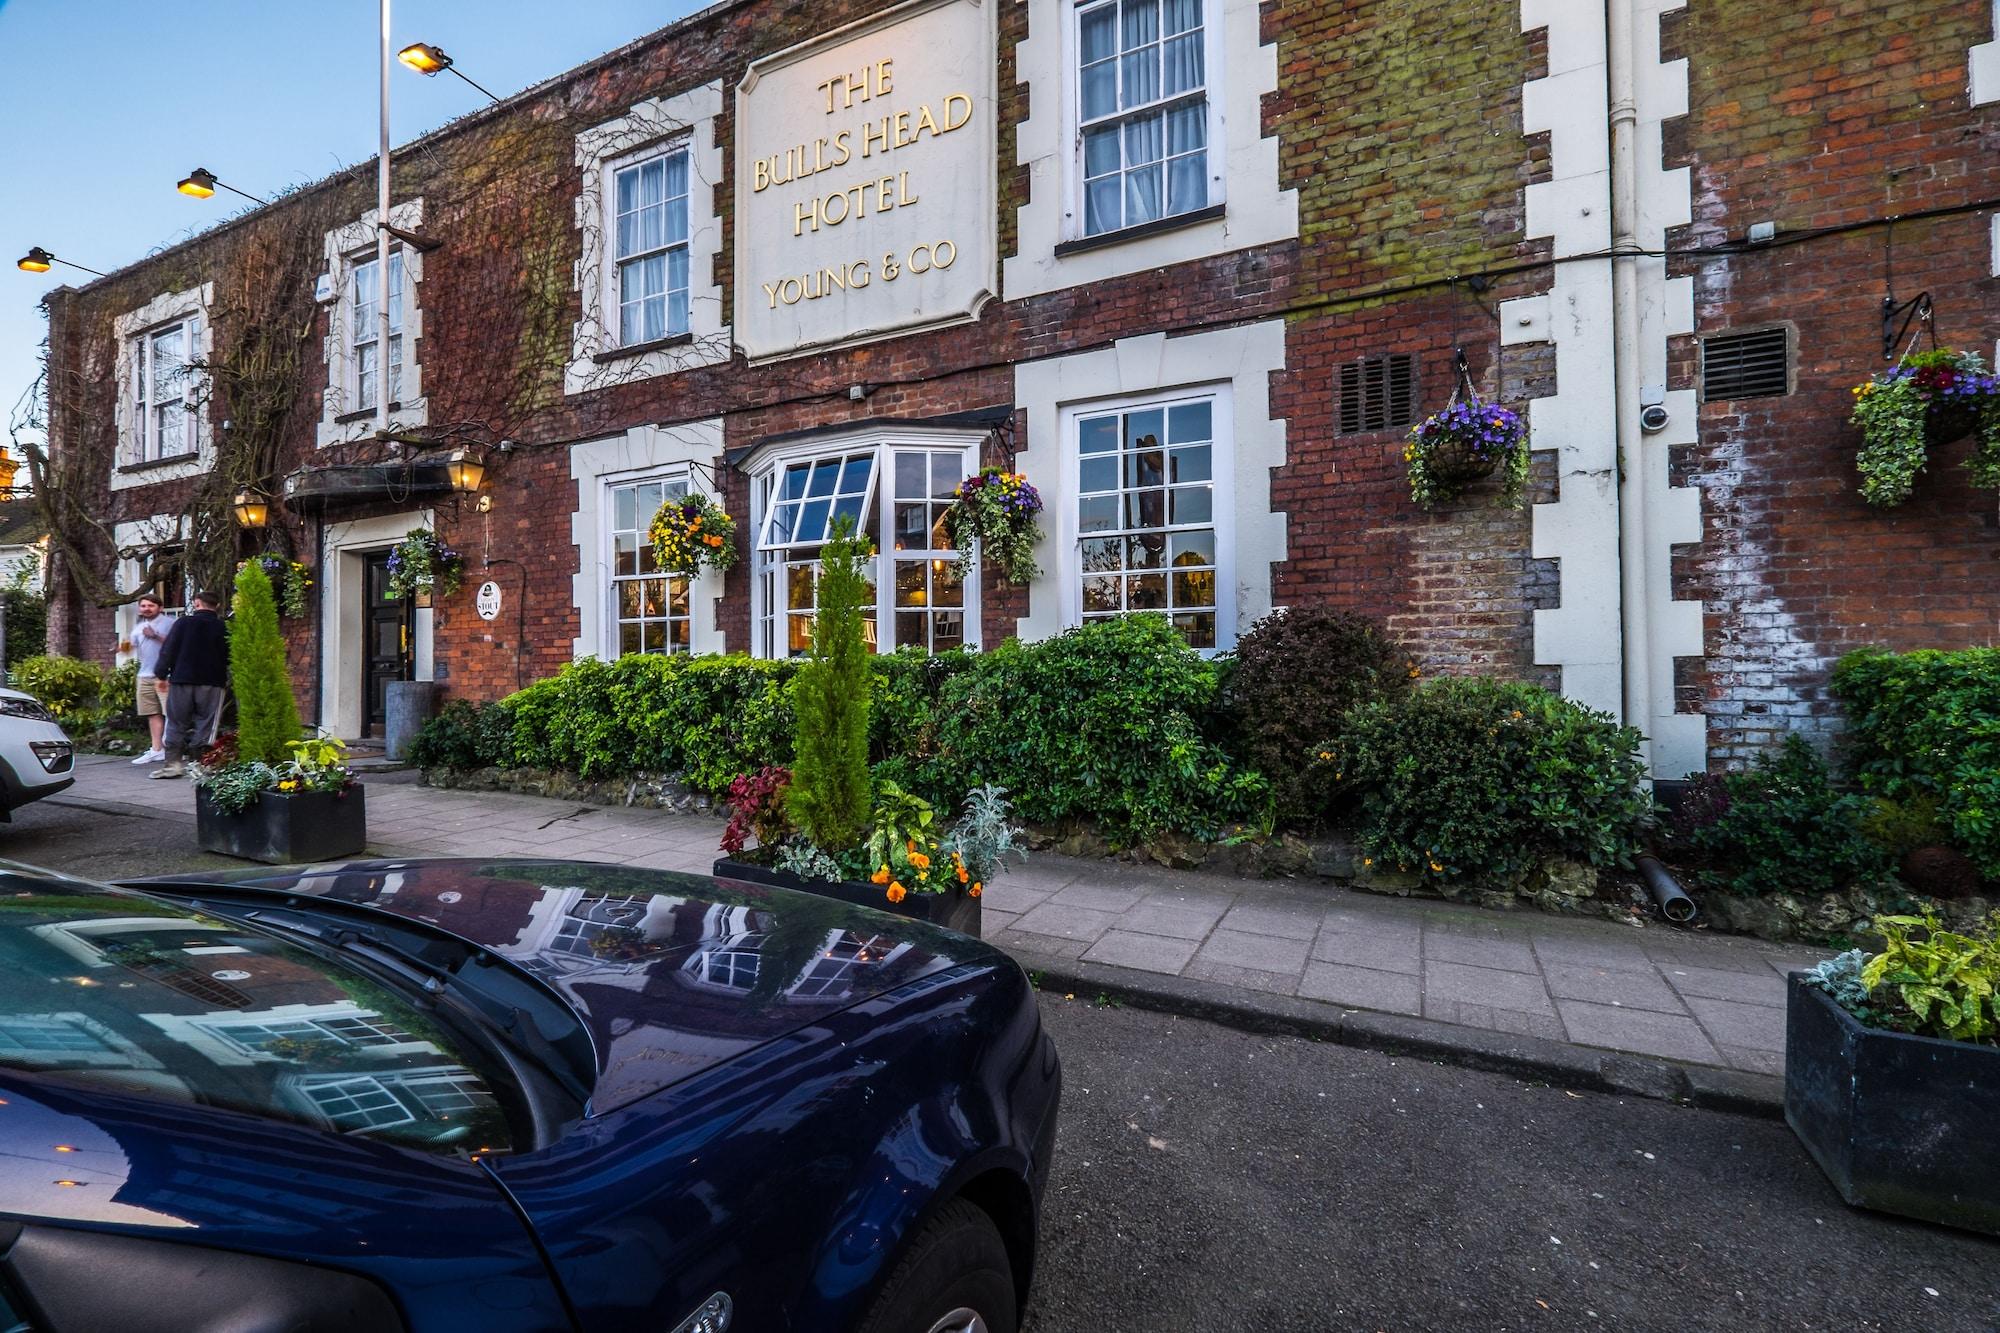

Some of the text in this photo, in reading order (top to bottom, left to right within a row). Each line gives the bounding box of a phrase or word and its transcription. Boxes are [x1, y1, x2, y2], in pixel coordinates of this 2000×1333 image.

[817, 57, 894, 115] THE
[862, 92, 973, 158] HEAD
[794, 171, 918, 236] HOTEL
[762, 239, 957, 310] YOUNG & CO
